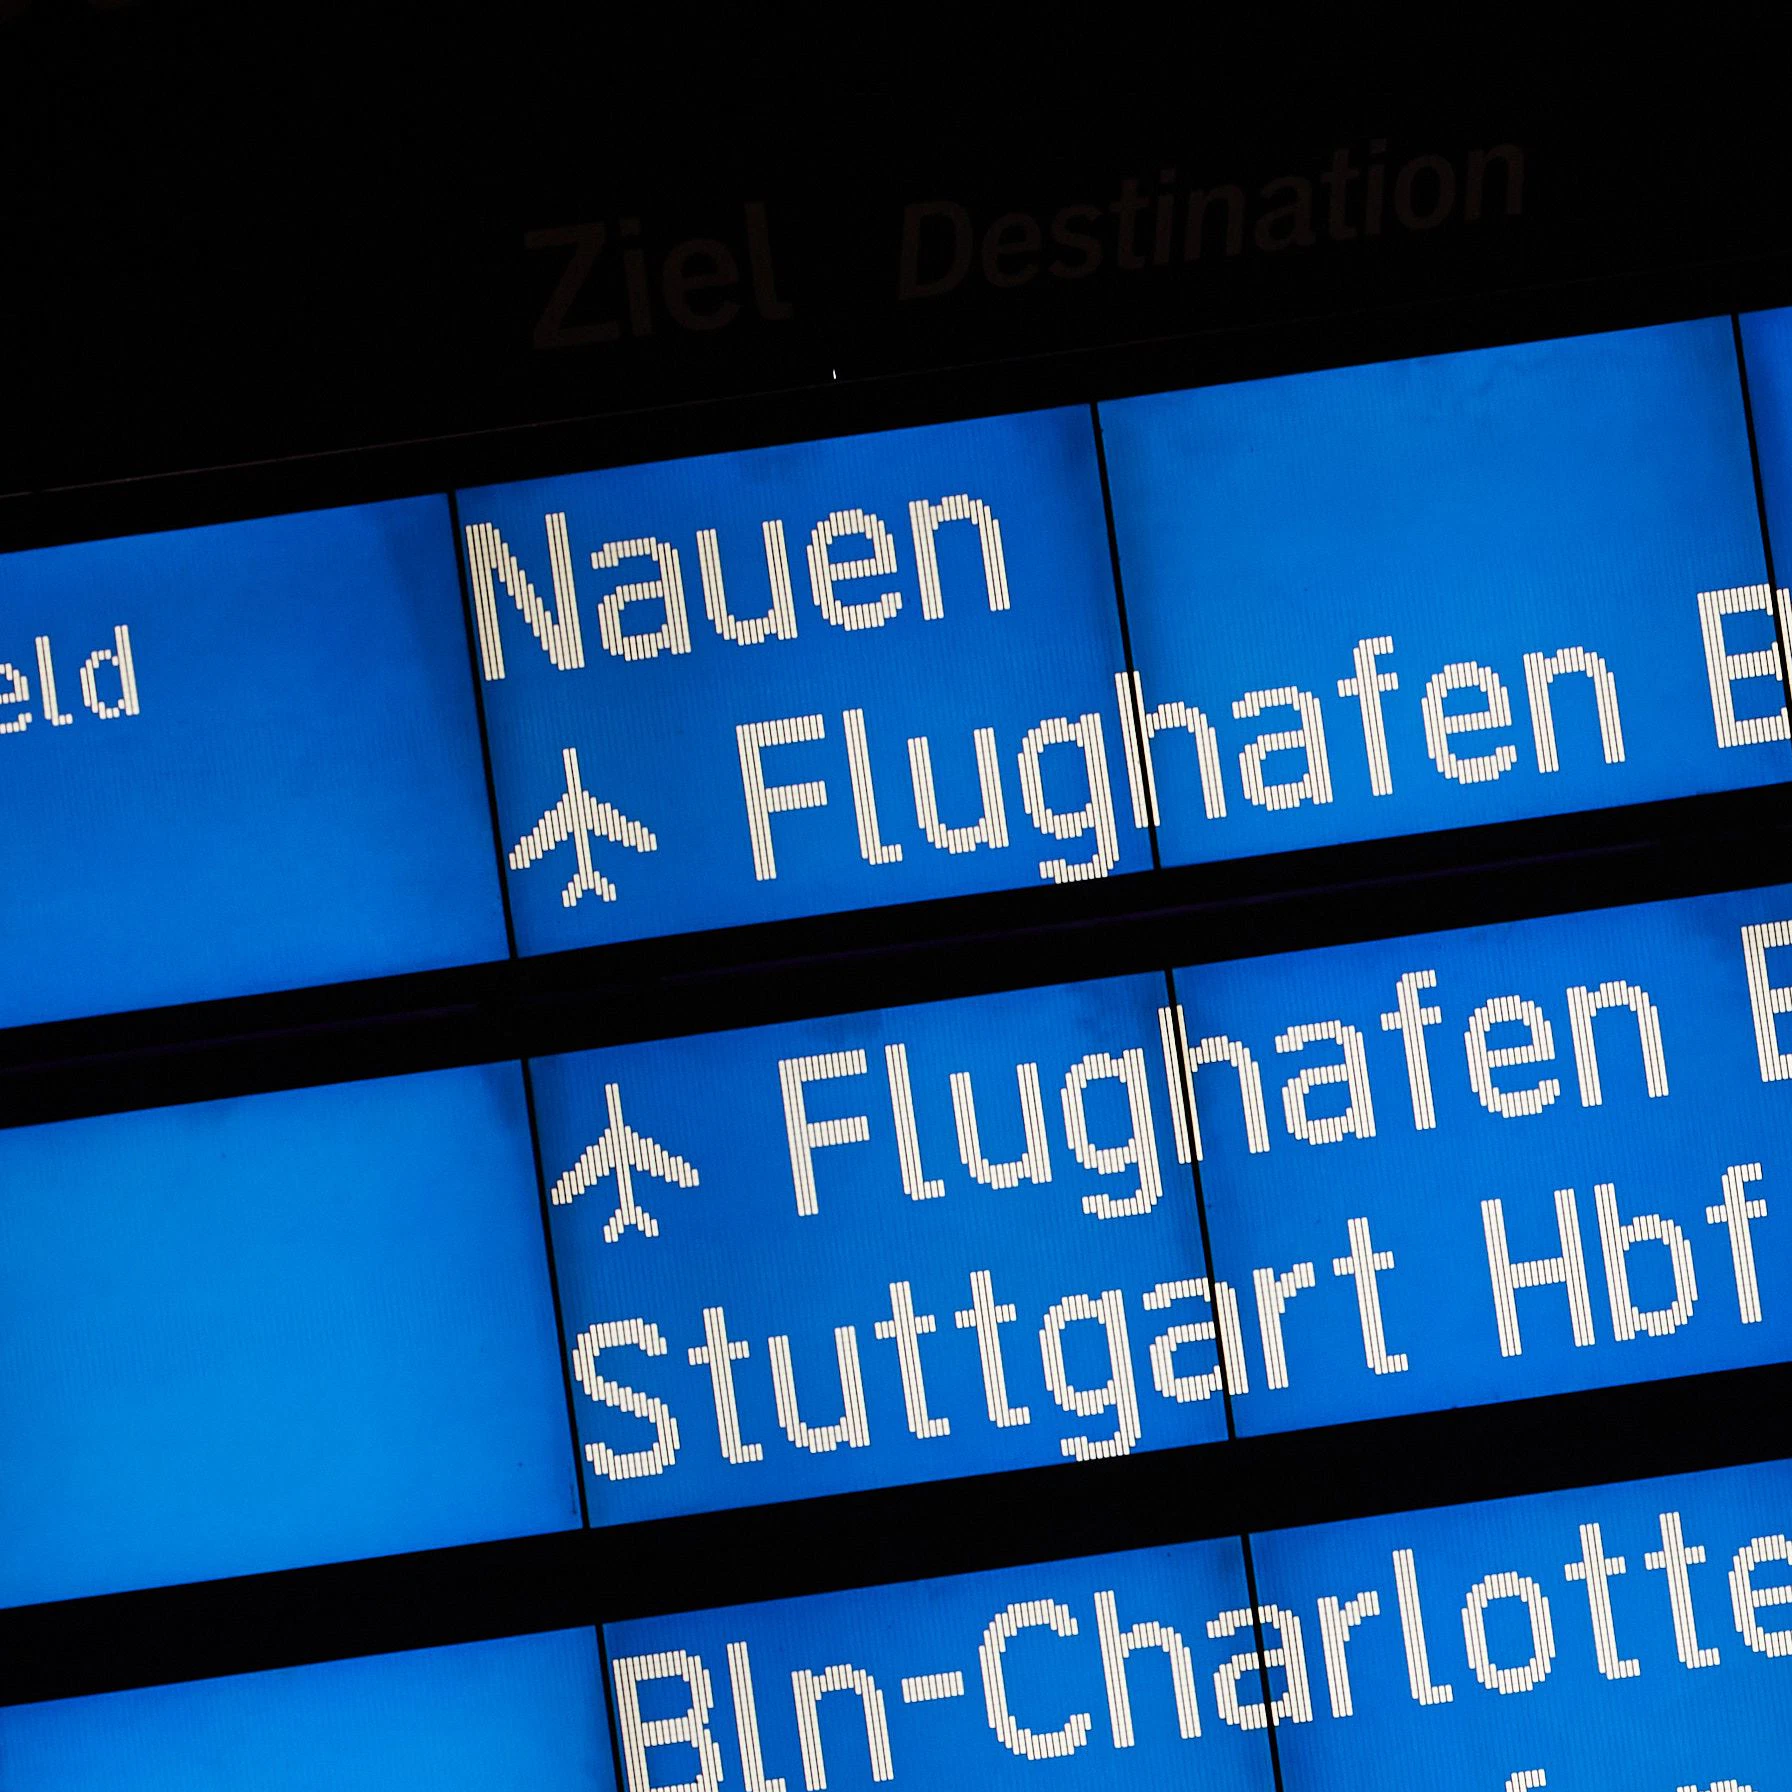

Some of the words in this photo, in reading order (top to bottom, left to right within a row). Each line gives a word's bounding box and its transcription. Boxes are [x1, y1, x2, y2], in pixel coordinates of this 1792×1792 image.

[524, 201, 790, 349] Ziel
[898, 139, 1526, 300] Destination
[464, 492, 1012, 682] Nauen
[734, 634, 1627, 885] Flughafen
[777, 968, 1670, 1221] Flughafen
[571, 1215, 1410, 1482] Stuttgart
[1479, 1161, 1769, 1358] Hbf
